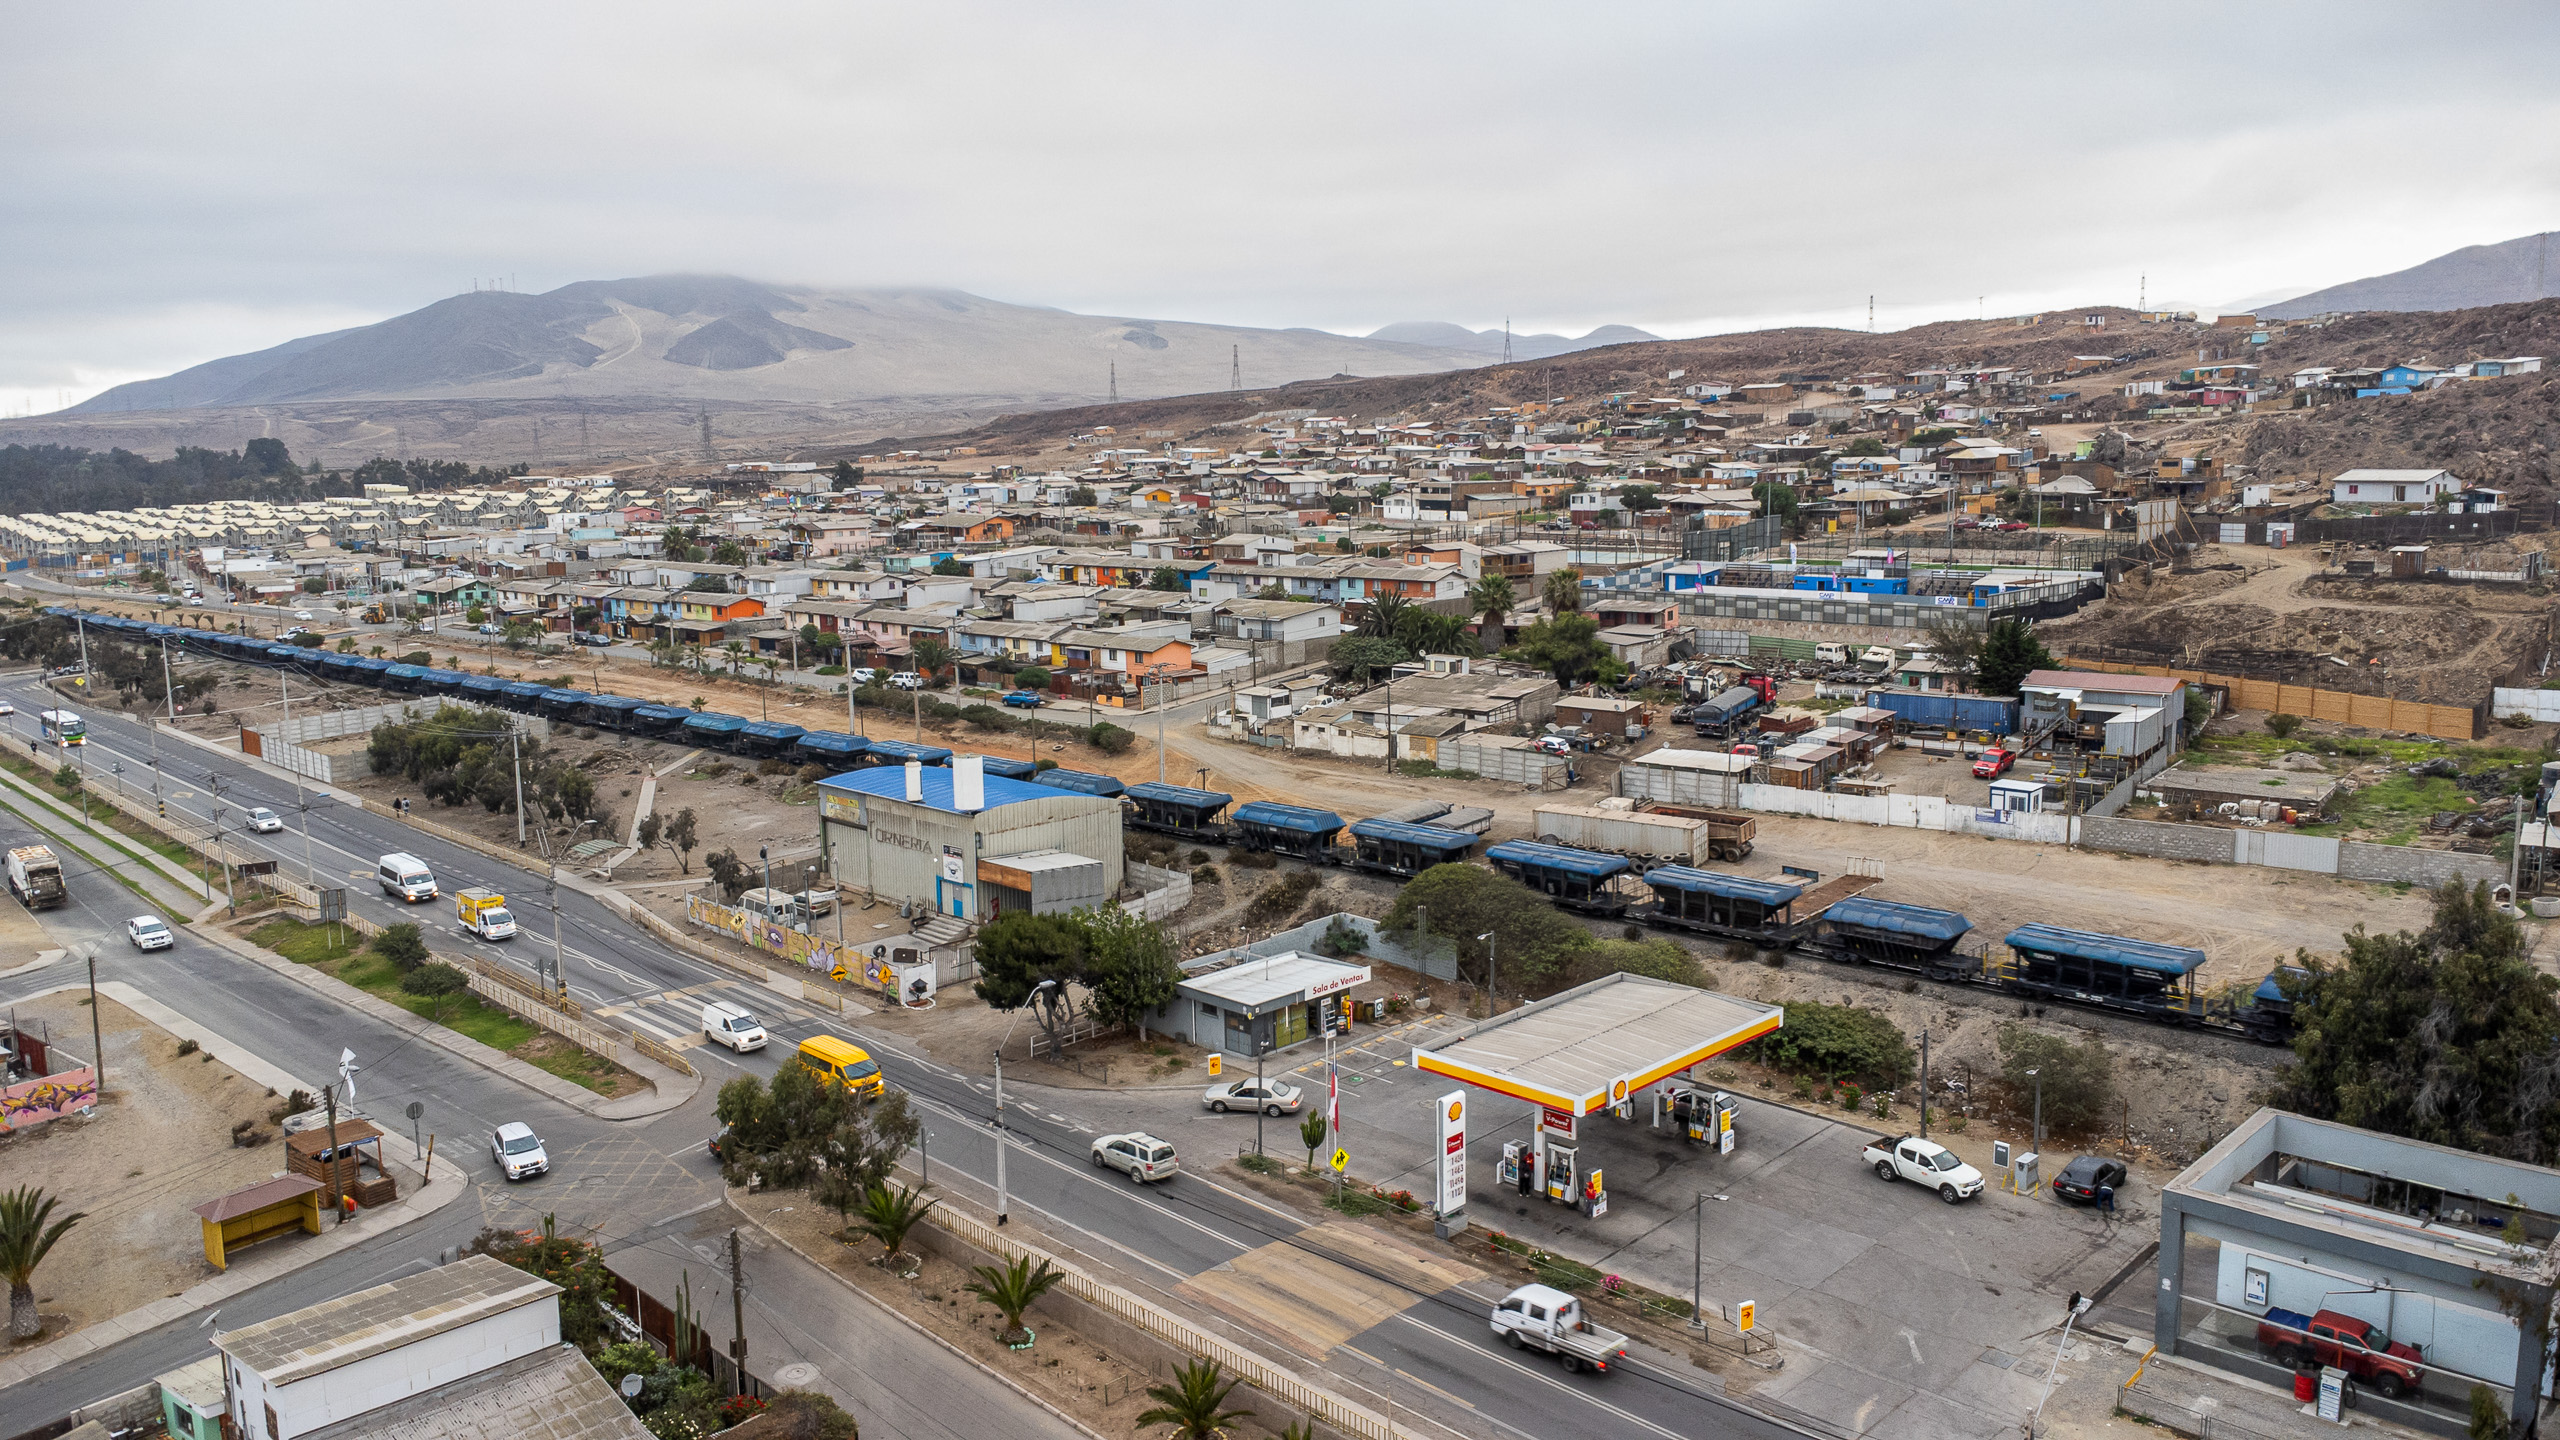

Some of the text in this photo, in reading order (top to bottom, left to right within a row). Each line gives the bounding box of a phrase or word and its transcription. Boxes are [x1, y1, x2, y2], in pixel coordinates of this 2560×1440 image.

[1312, 974, 1364, 995] Sala de Ventas
